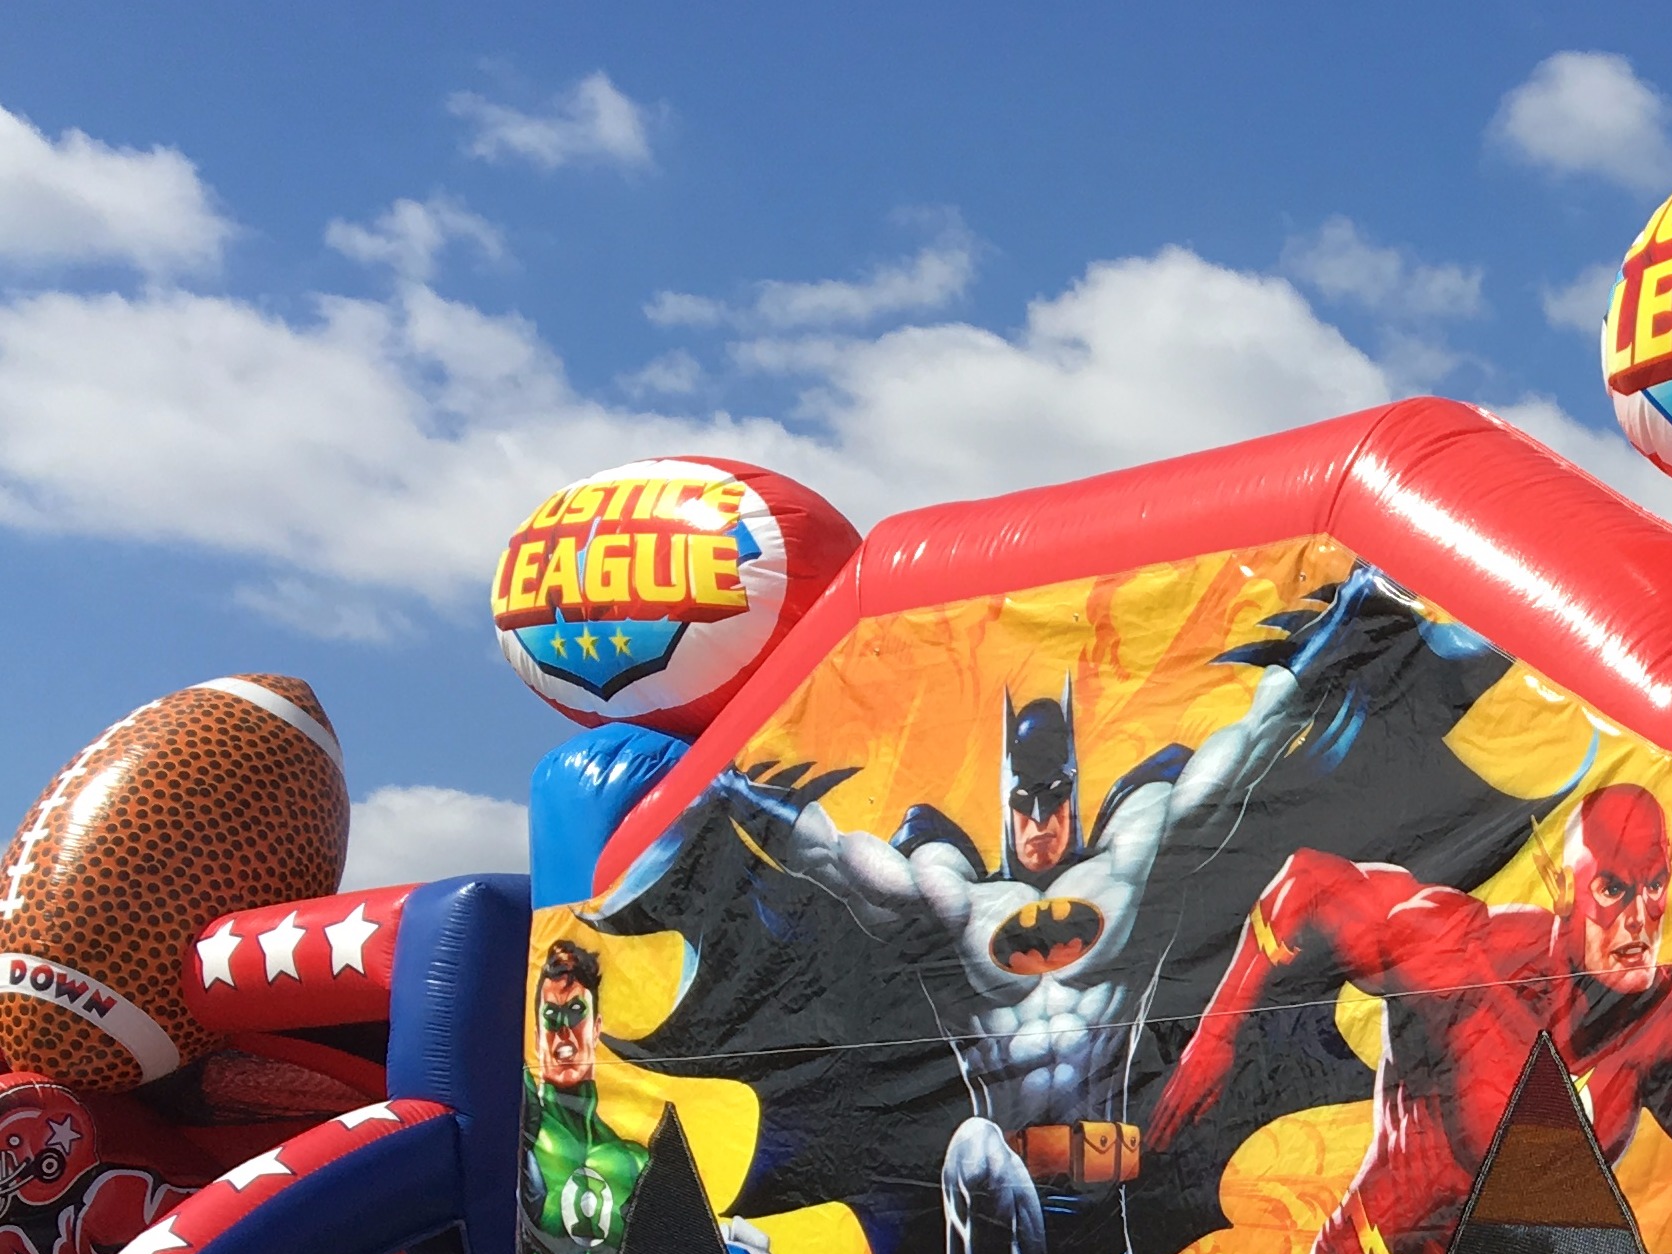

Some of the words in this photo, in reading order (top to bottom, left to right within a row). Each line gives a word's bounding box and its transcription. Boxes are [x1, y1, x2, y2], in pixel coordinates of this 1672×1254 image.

[512, 477, 748, 534] JUSTICE
[491, 532, 749, 617] LEAGUE
[9, 959, 118, 1019] DOWN
